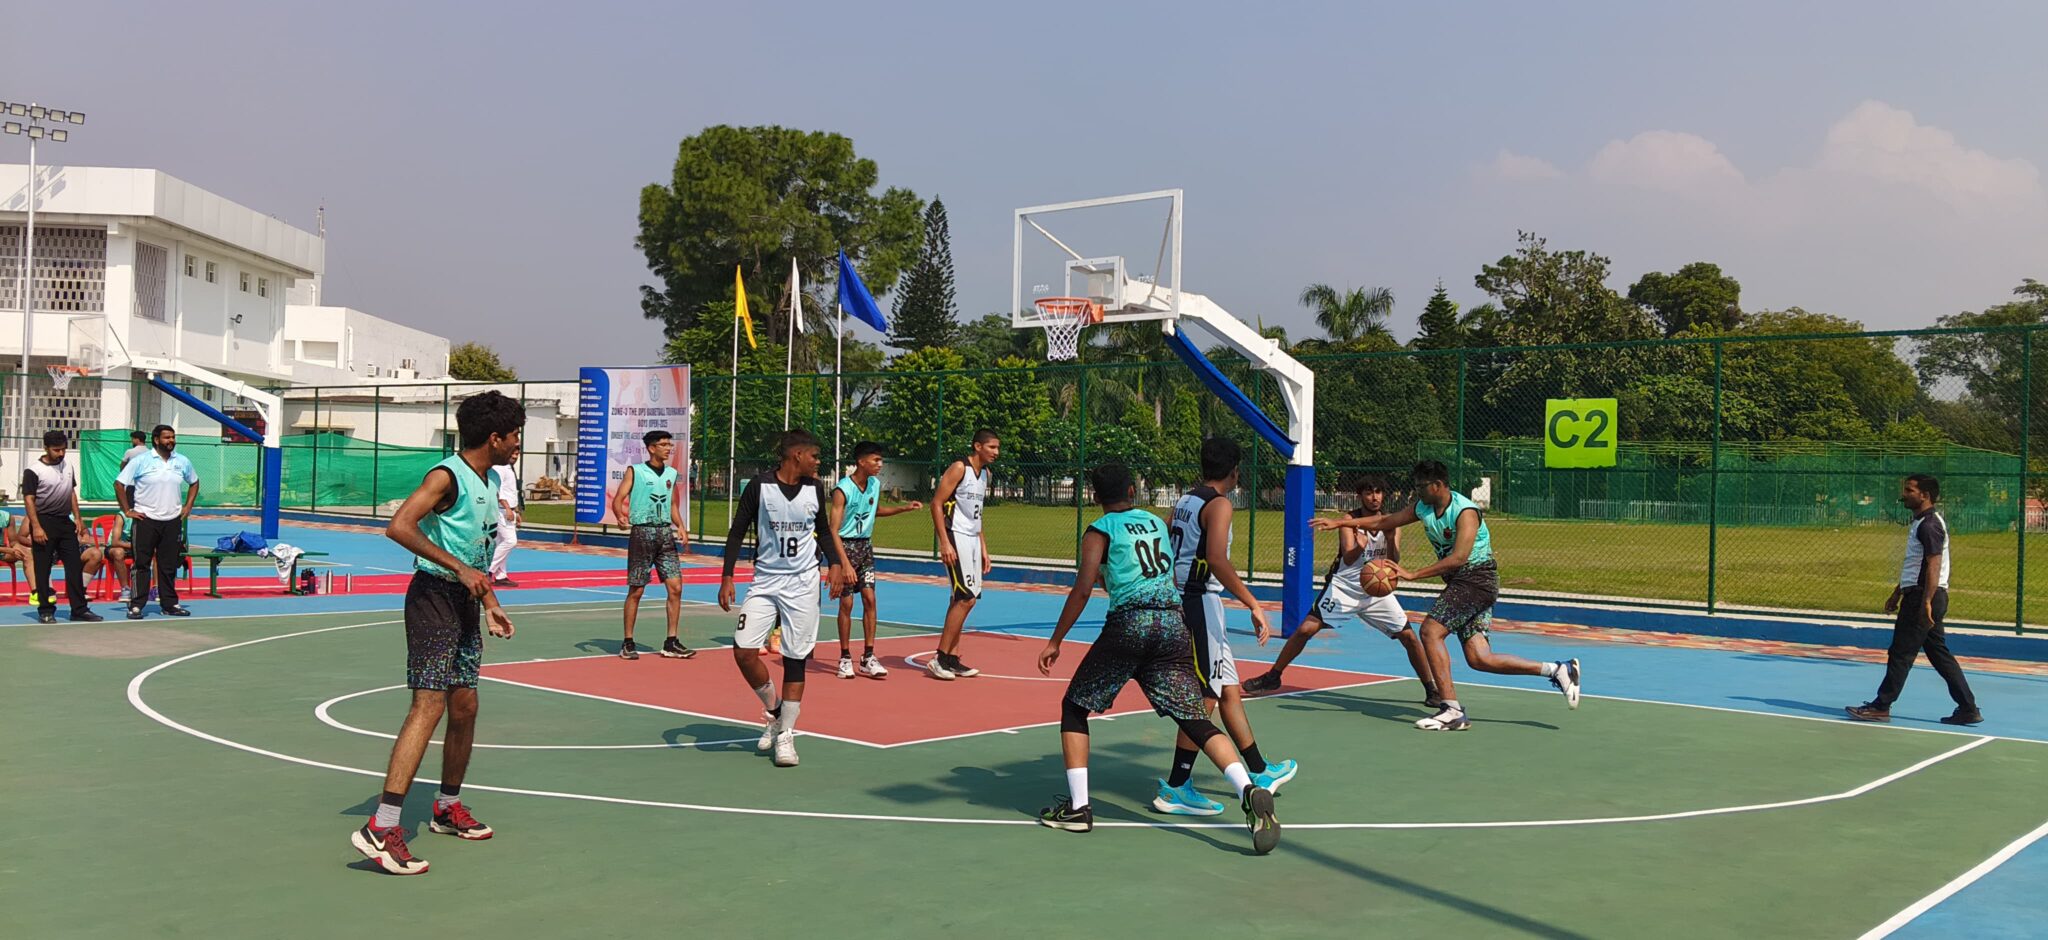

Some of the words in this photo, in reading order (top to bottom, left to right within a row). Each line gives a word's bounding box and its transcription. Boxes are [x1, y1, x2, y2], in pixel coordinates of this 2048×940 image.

[1549, 410, 1608, 448] C2
[1124, 519, 1159, 535] RAJ
[779, 536, 798, 558] 18
[1134, 537, 1172, 579] 06
[1320, 597, 1336, 613] 23
